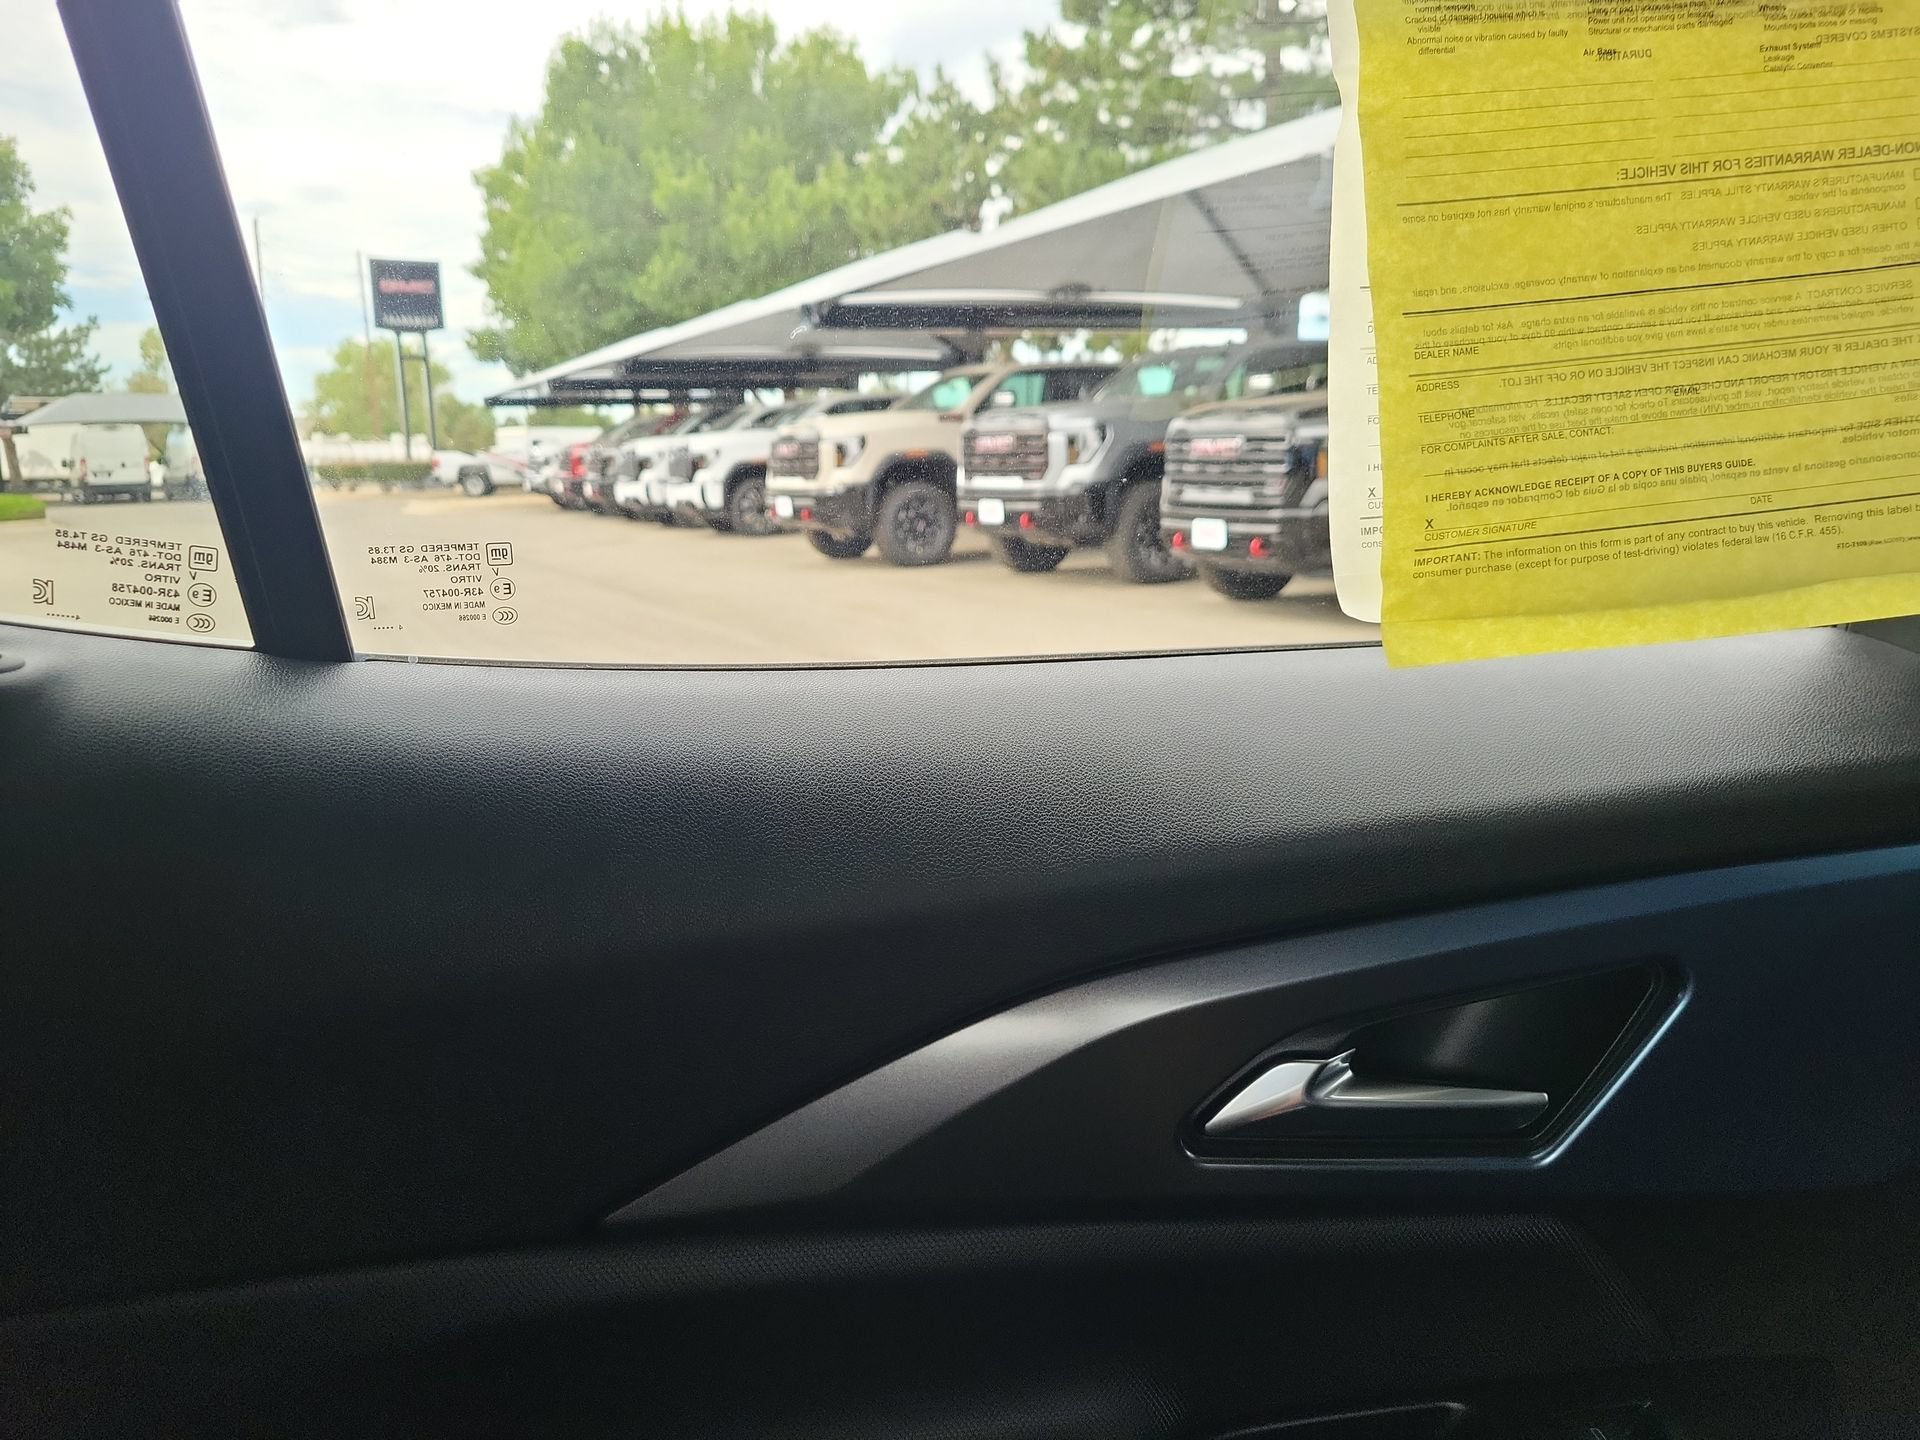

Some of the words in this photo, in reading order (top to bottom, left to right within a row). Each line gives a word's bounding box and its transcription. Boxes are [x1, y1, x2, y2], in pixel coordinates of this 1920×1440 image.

[1405, 16, 1436, 24] Cracked
[1588, 27, 1621, 35] Structural
[1633, 23, 1674, 32] mechanical
[1677, 22, 1695, 30] parts
[1698, 18, 1733, 27] damaged
[1418, 25, 1441, 33] visible
[1407, 36, 1442, 45] Abnormal
[1475, 34, 1505, 42] vibration
[1508, 31, 1535, 39] caused
[1538, 31, 1546, 39] by
[1549, 29, 1568, 38] faulty
[1419, 46, 1455, 55] differential
[1759, 43, 1790, 53] Exhaust
[1793, 42, 1821, 50] System
[1415, 349, 1450, 360] DEALER
[1453, 346, 1479, 357] NAME
[1416, 381, 1460, 392] ADDRESS
[1419, 409, 1475, 424] TELEPHONE
[1421, 443, 1441, 455] FOR
[1444, 438, 1505, 452] COMPLAINTS
[1508, 434, 1539, 445] AFTER
[1431, 490, 1471, 502] HEREBY
[1475, 481, 1551, 498] ACKNOWLEDGE
[1555, 476, 1594, 488] RECEIPT
[1598, 474, 1611, 484] OF
[1613, 473, 1620, 481] A
[1622, 470, 1648, 480] COPY
[1650, 467, 1662, 477] OF
[1665, 464, 1684, 475] THIS
[1688, 461, 1723, 473] BUYERS
[1725, 459, 1755, 469] GUIDE.
[1368, 488, 1376, 497] X
[1751, 494, 1772, 505] DATE
[1425, 518, 1434, 529] X
[1414, 552, 1480, 567] IMPORTANT:
[1483, 549, 1503, 561] The
[1506, 545, 1561, 558] information
[1565, 544, 1577, 553] on
[1580, 540, 1597, 551] this
[1600, 537, 1621, 548] form
[1624, 537, 1631, 547] is
[1634, 532, 1652, 546] part
[1654, 531, 1665, 541] of
[1668, 531, 1685, 542] any
[1688, 525, 1726, 538] contract
[1728, 526, 1737, 535] to
[1740, 522, 1755, 535] buy
[1758, 519, 1773, 530] this
[1775, 516, 1808, 528] vehicle.
[1815, 510, 1863, 524] Removing
[1866, 507, 1884, 517] this
[1887, 503, 1912, 515] label
[1424, 528, 1479, 542] CUSTOMER
[1482, 521, 1536, 535] SIGNATURE
[1413, 566, 1461, 579] consumer
[1465, 562, 1512, 576] purchase
[1515, 559, 1551, 572] (except
[1554, 556, 1567, 566] for
[1571, 553, 1610, 567] purpose
[1612, 550, 1622, 561] of
[1624, 544, 1679, 559] test-driving)
[1682, 538, 1719, 551] violates
[1721, 534, 1752, 546] federal
[1754, 531, 1770, 542] law
[1772, 530, 1786, 542] (16
[1789, 527, 1816, 539] C.F.R.
[1819, 525, 1844, 536] 455).
